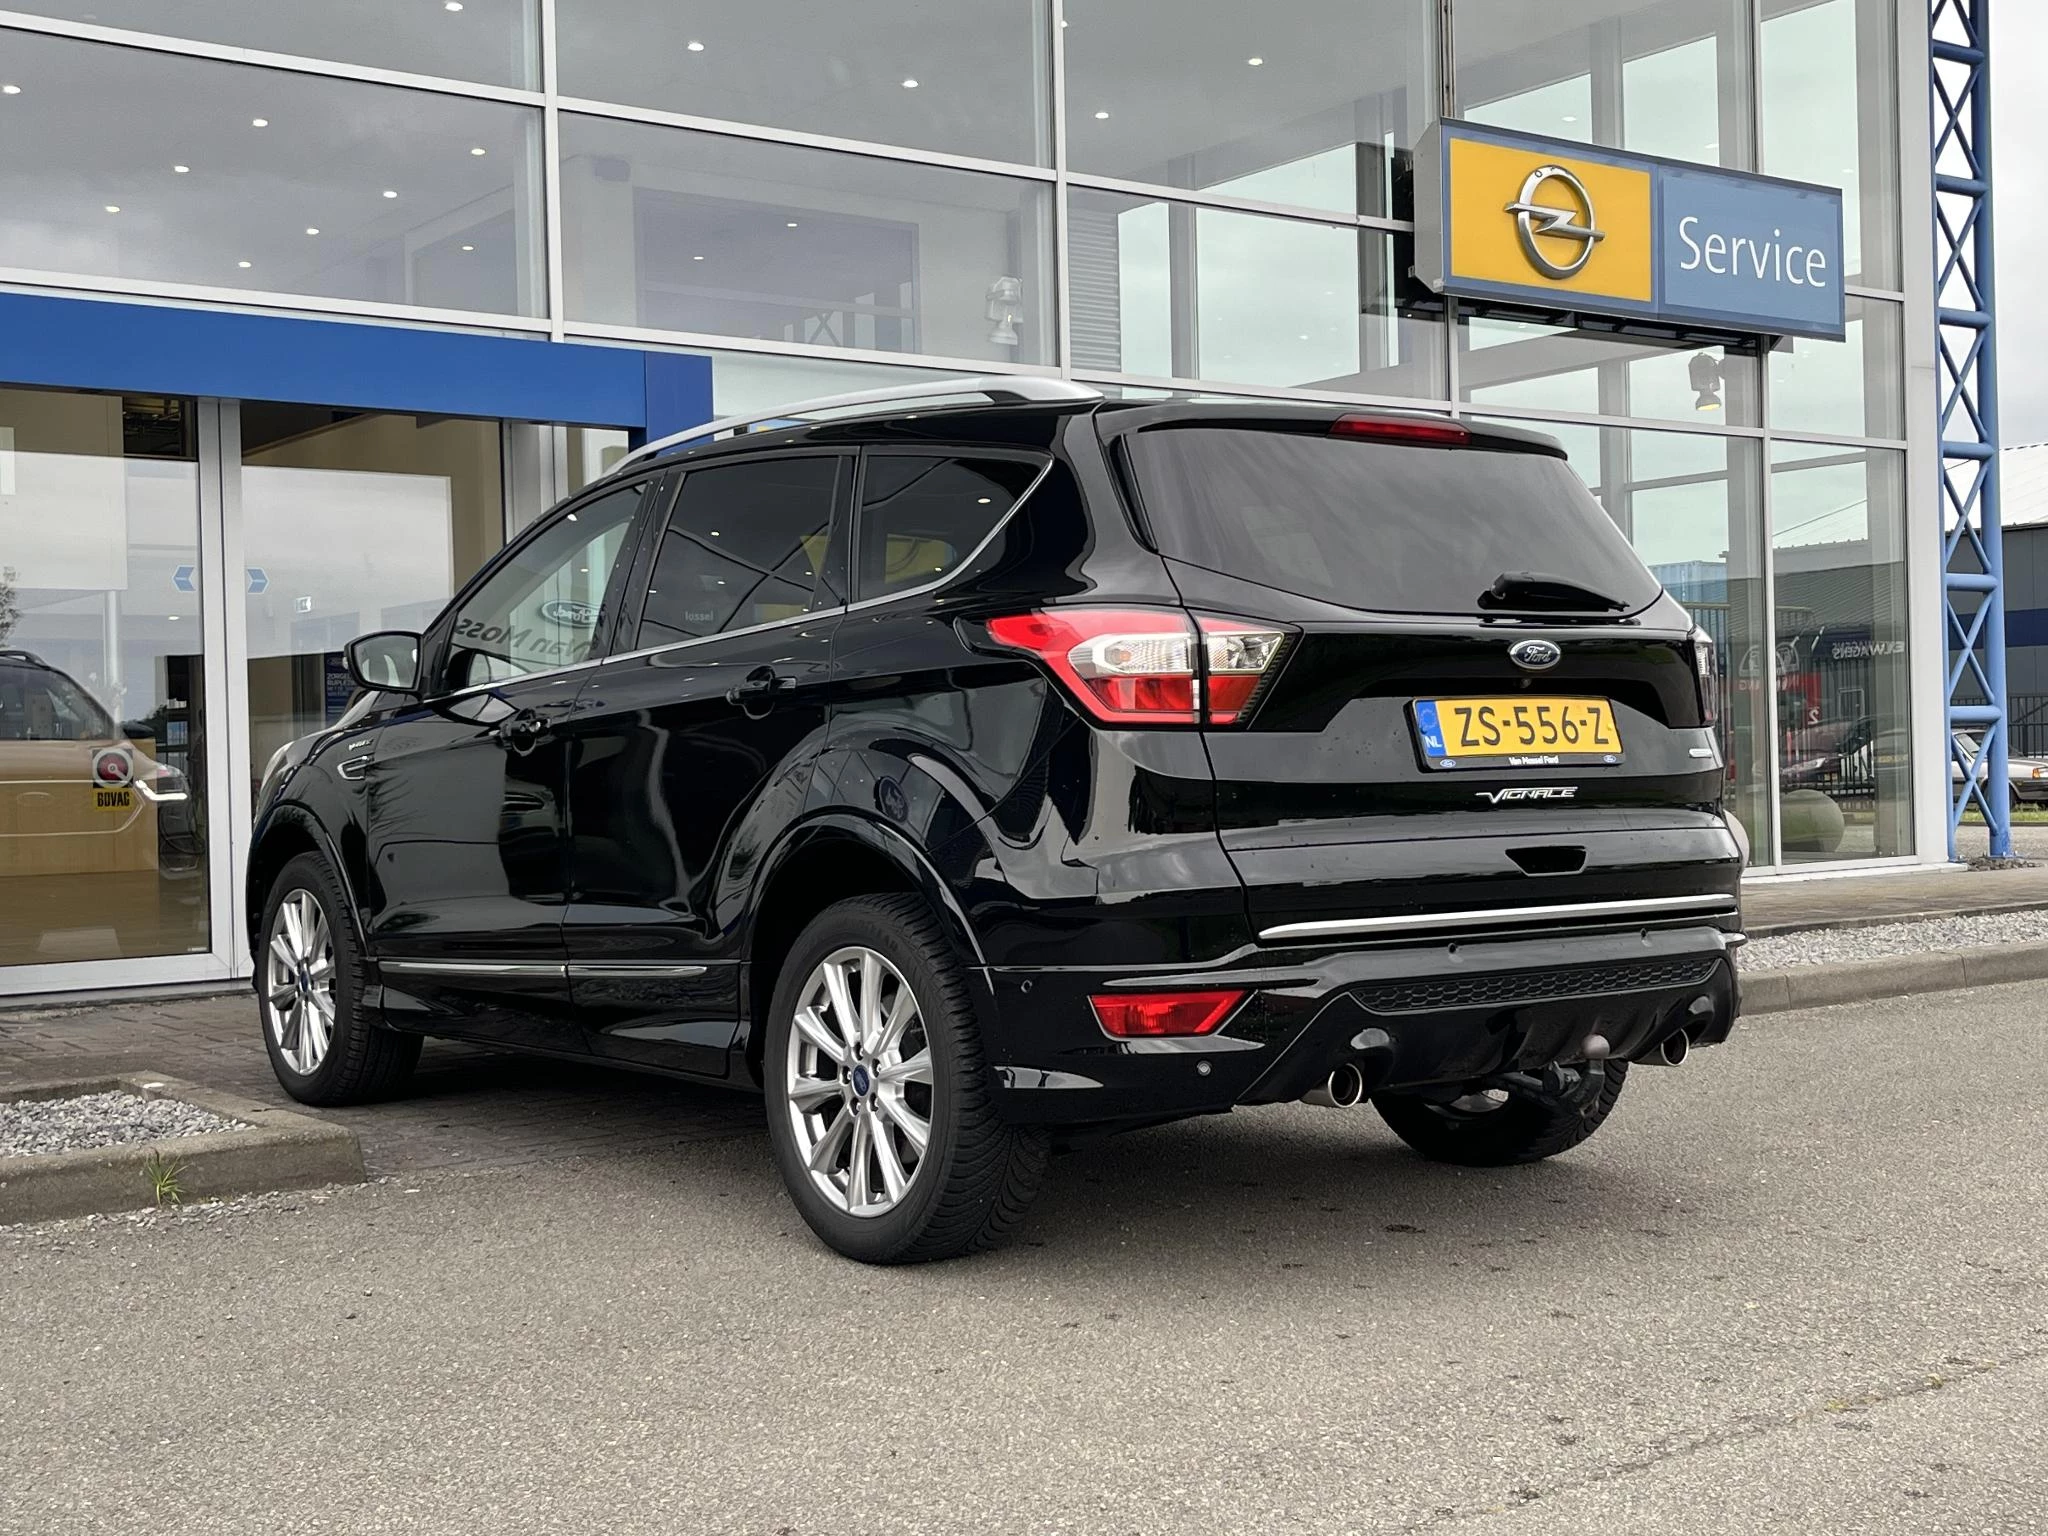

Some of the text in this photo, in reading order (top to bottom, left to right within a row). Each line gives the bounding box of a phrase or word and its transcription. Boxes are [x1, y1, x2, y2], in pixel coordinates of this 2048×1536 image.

[1678, 216, 1826, 288] Service
[1524, 645, 1552, 663] Ford
[1454, 705, 1610, 747] ZS-556-Z
[1424, 735, 1442, 748] NL
[97, 791, 130, 808] BOVAG
[1475, 786, 1579, 804] VIGNALE
